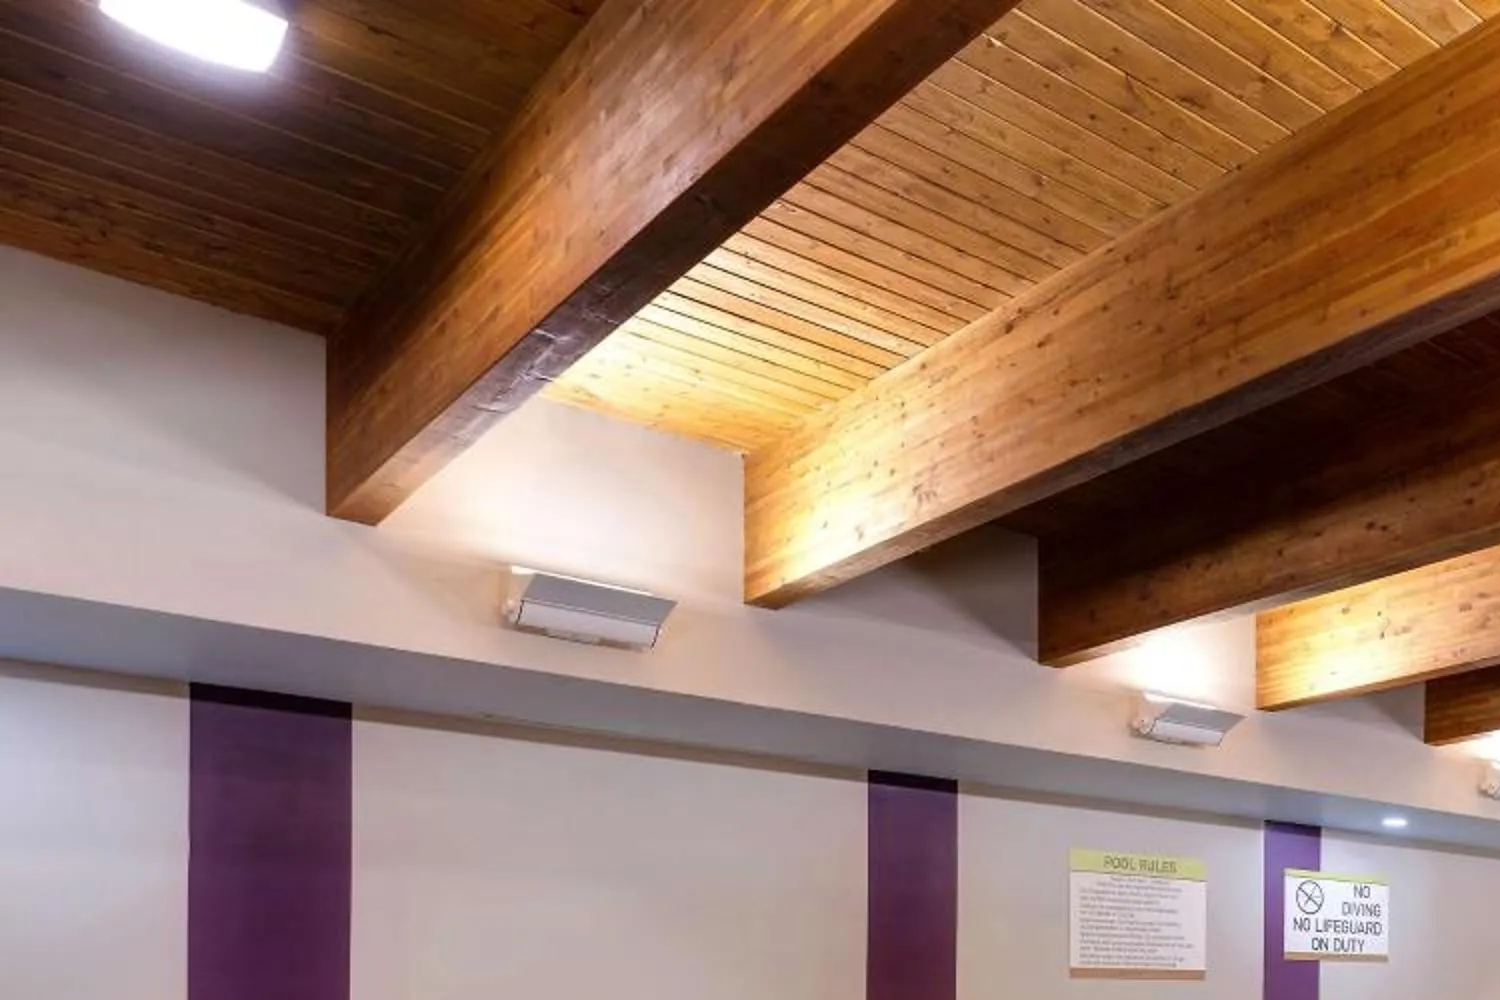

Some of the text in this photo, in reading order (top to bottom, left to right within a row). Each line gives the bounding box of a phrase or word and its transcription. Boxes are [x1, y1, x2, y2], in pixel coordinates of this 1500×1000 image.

[1103, 855, 1177, 874] POOL RULES
[1353, 884, 1371, 899] NO
[1341, 901, 1381, 917] DIVING
[1293, 917, 1382, 936] NO LIFEGUARD
[1311, 937, 1365, 952] ON DUTY
